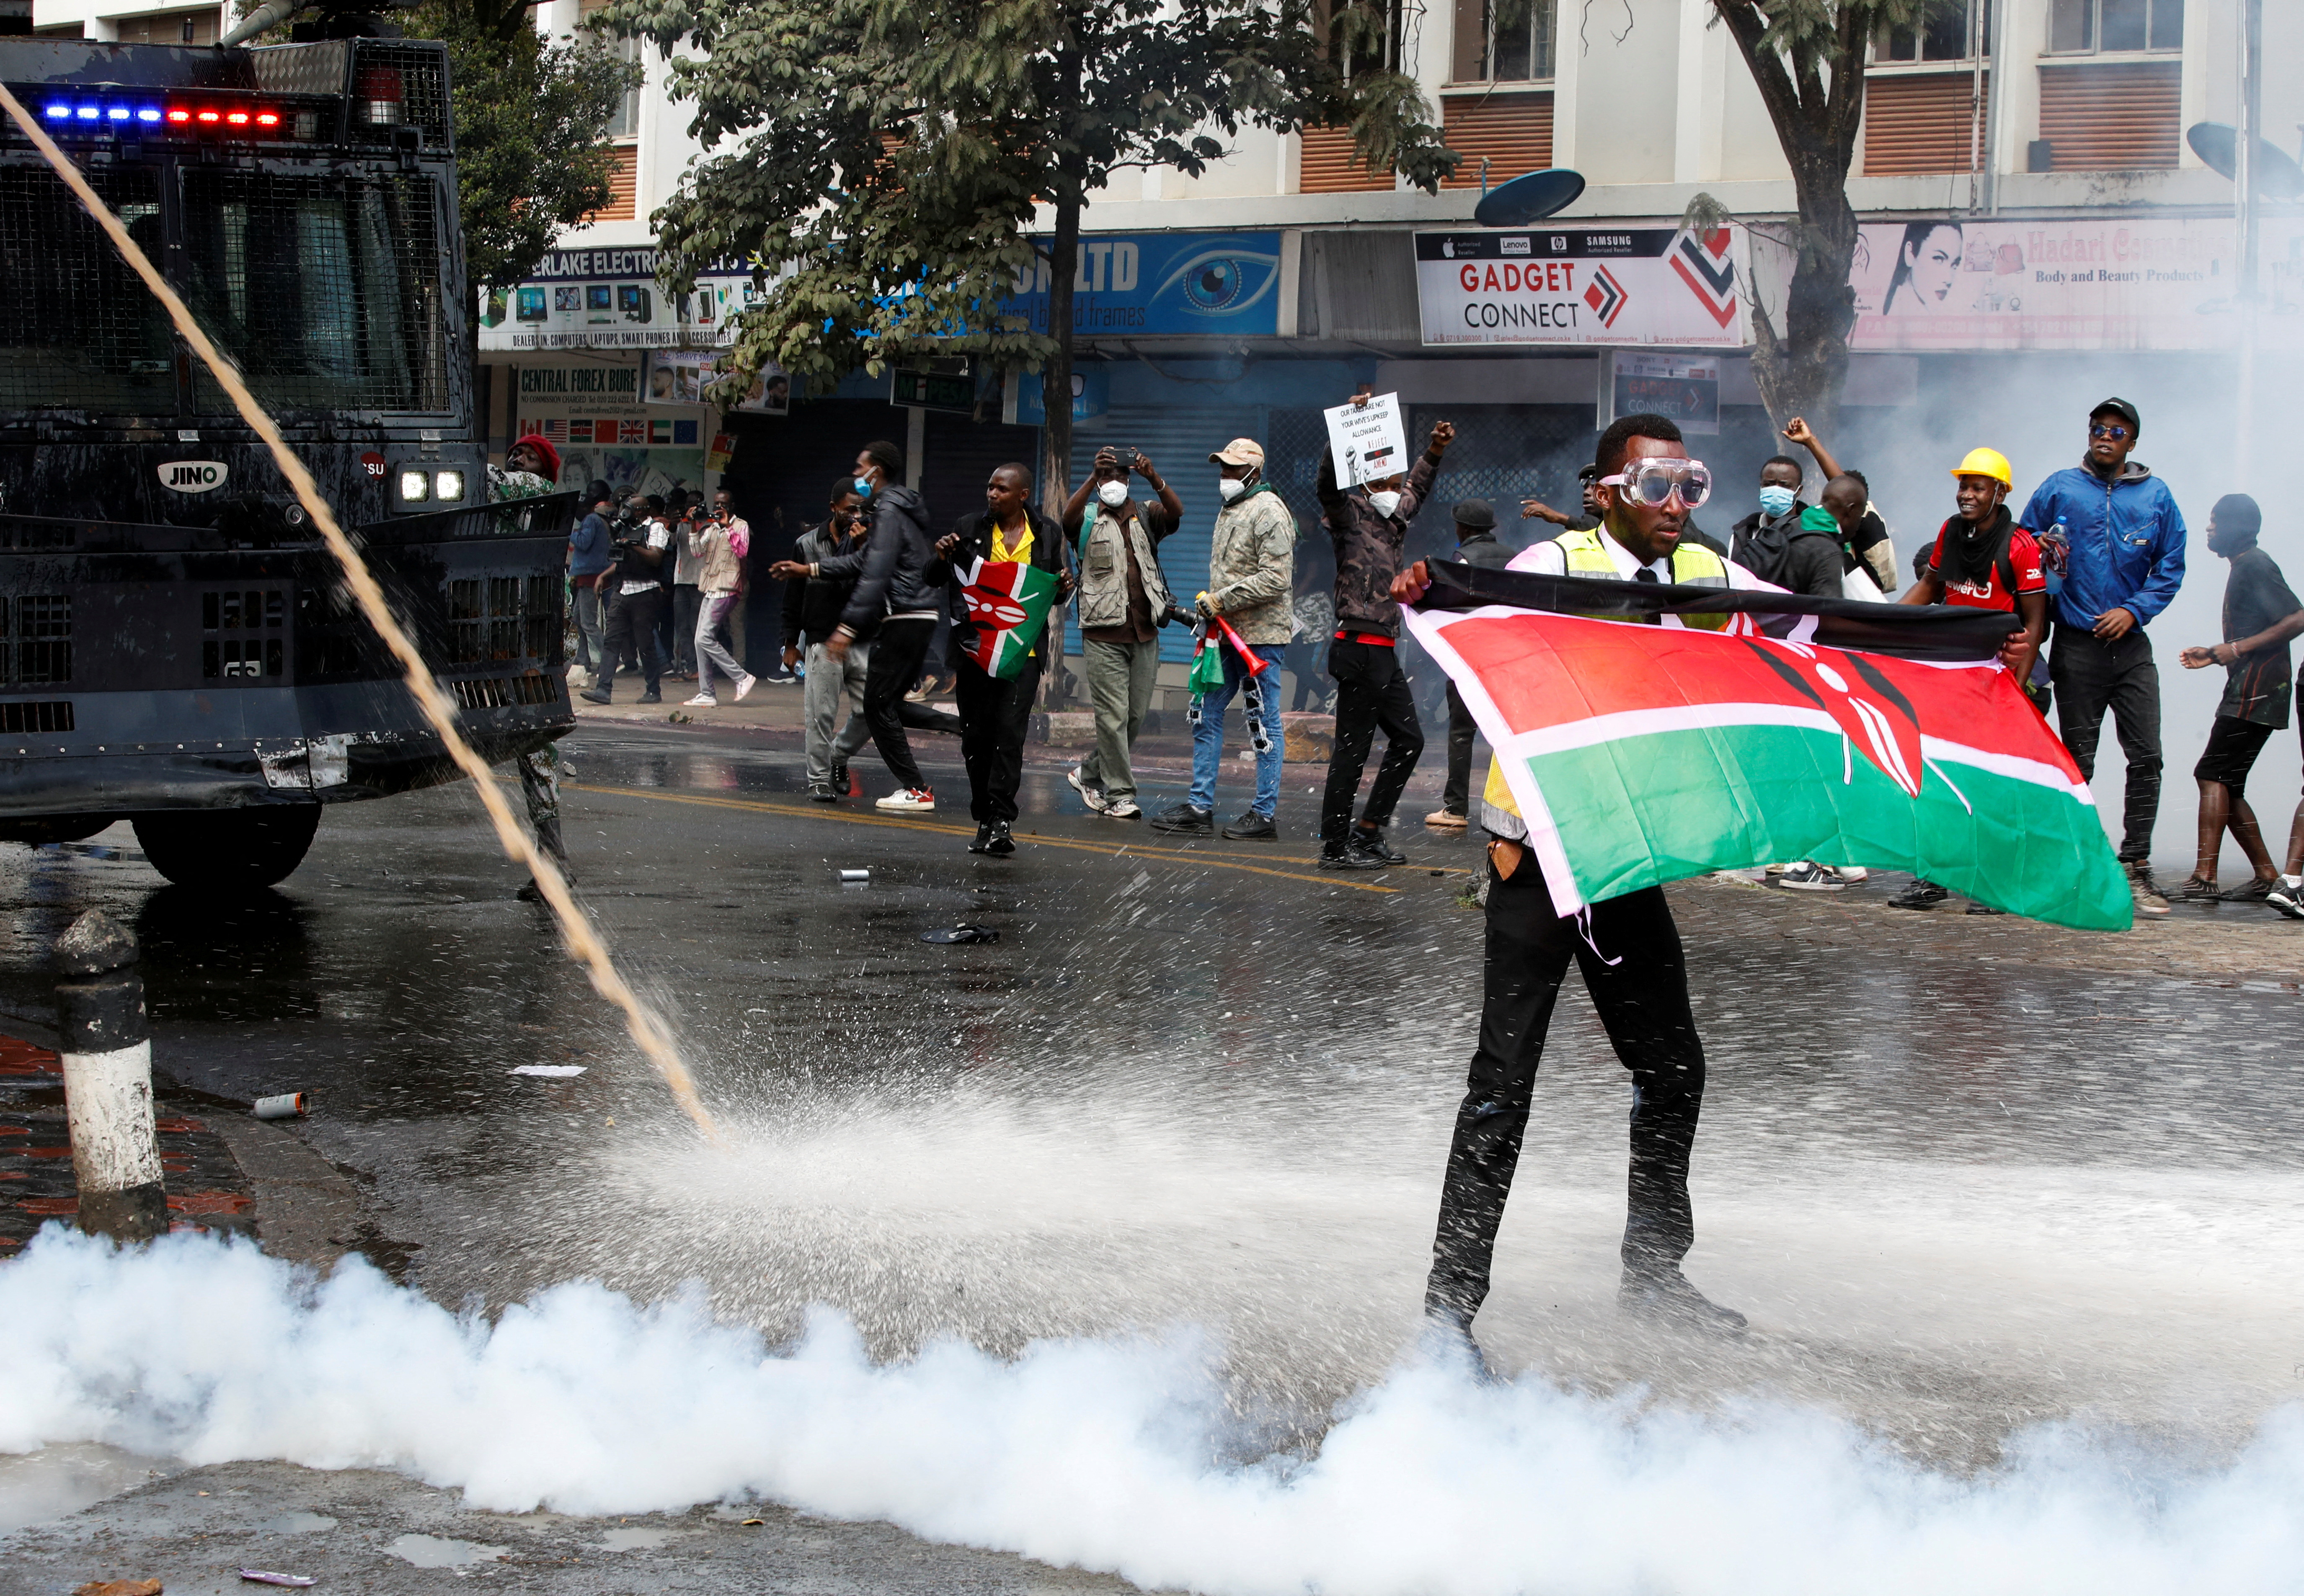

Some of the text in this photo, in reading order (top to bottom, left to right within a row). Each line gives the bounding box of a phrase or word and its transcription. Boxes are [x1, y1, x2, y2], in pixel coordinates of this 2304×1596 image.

[1587, 235, 1631, 246] SAMSUNG
[2027, 230, 2106, 263] Hadari
[1074, 242, 1139, 292] LTD
[1460, 263, 1574, 292] GADGET
[2036, 269, 2204, 285] Body and Beauty Products
[1089, 297, 1145, 326] frames
[1465, 303, 1578, 328] CONNECT
[513, 335, 540, 347] DEALERS
[541, 335, 549, 347] IN:
[590, 333, 620, 345] LAPTOPS,
[622, 332, 644, 345] SMART
[646, 332, 670, 344] PHONES
[672, 332, 686, 343] AND
[687, 331, 731, 344] ACCESSORIES
[676, 352, 697, 361] SHAVE
[699, 354, 721, 362] SMAR
[522, 369, 637, 392] CENTRAL FOREX BURE
[1628, 380, 1683, 396] GADGET
[1350, 405, 1364, 414] TAXES
[1365, 402, 1374, 411] ARE
[1628, 400, 1682, 413] CONNECT
[1341, 420, 1354, 429] YOUR
[1371, 411, 1389, 421] UPKEEP
[1352, 425, 1382, 438] ALLOWANCE
[1368, 436, 1387, 449] REJECT
[170, 467, 217, 485] JINO
[363, 463, 384, 475] SU
